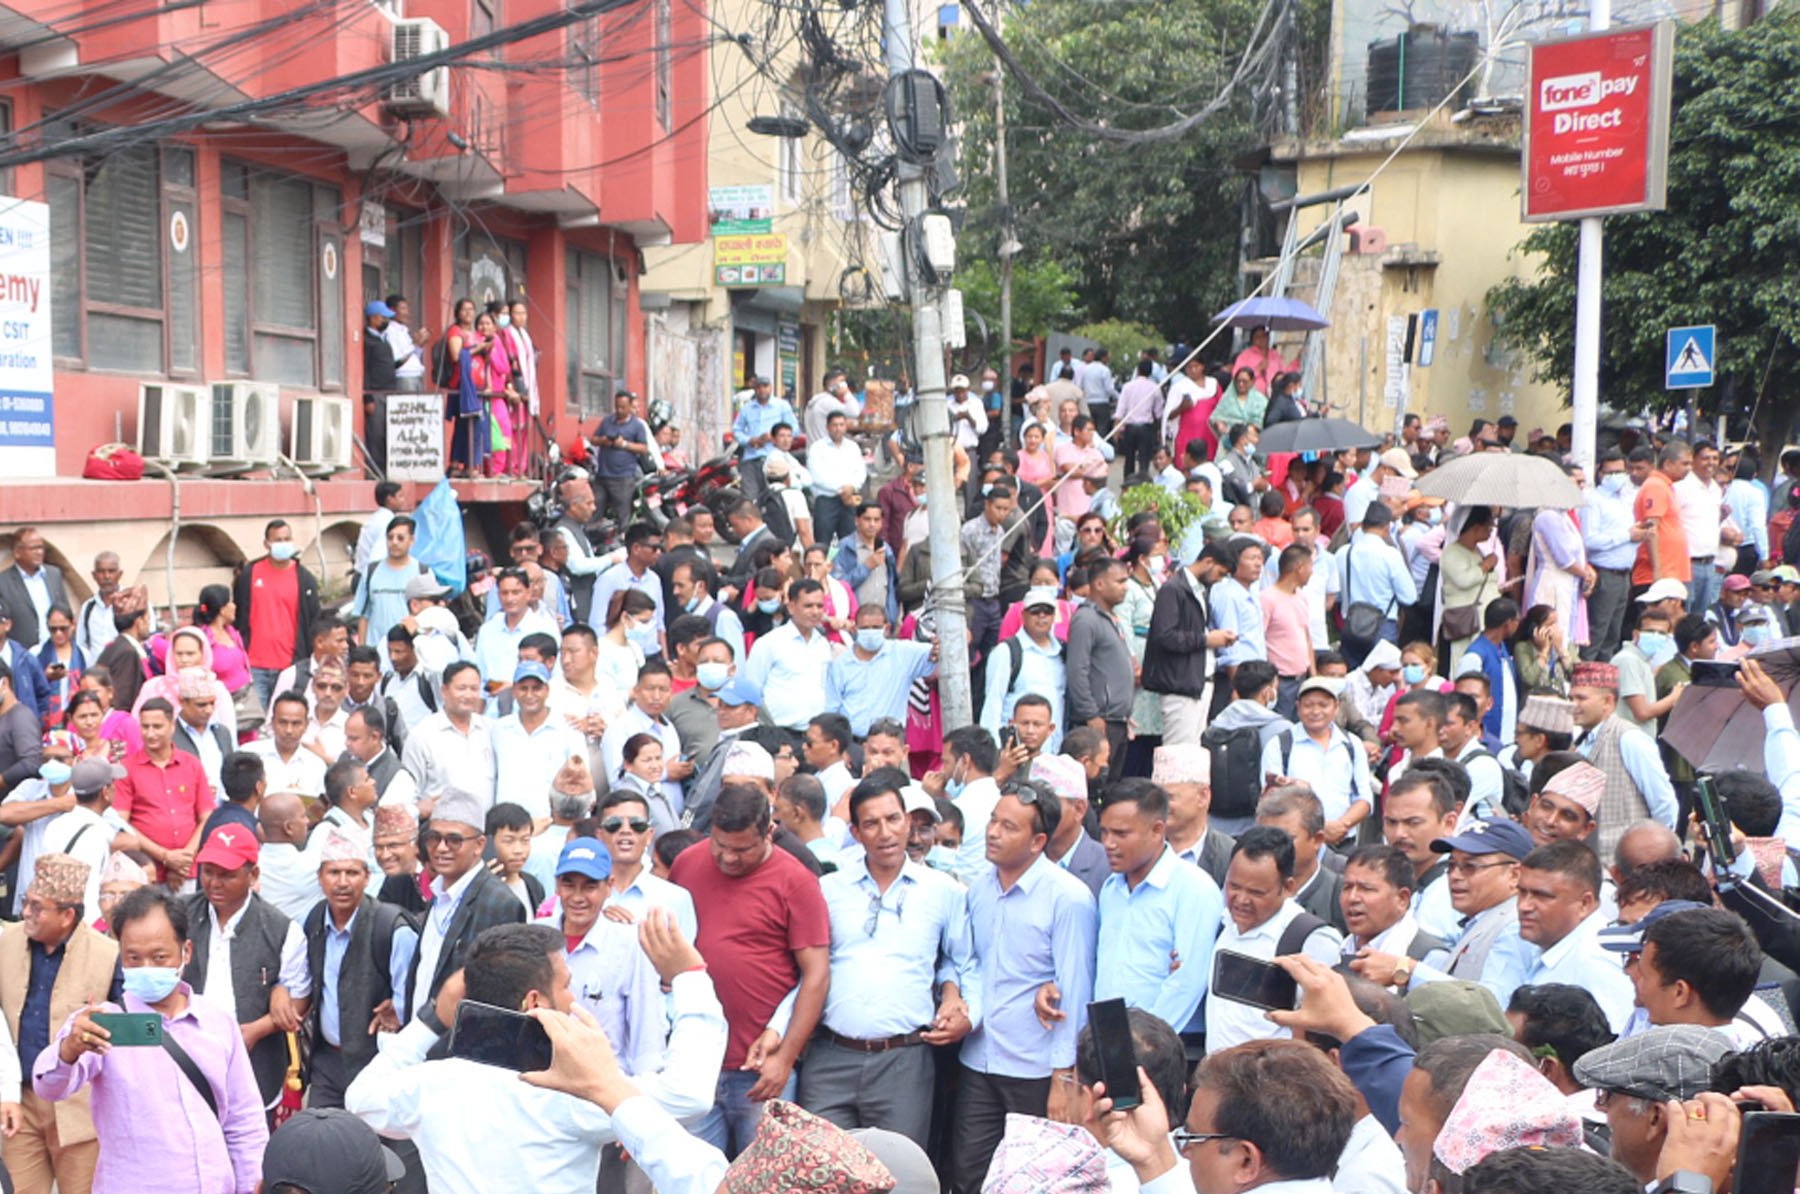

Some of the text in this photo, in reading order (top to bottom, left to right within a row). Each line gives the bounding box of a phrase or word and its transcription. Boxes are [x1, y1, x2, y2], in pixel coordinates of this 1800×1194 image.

[1543, 74, 1638, 105] fonepay
[1554, 108, 1622, 134] Direct
[1550, 147, 1624, 166] Mobile Number
[3, 321, 30, 340] CSIT
